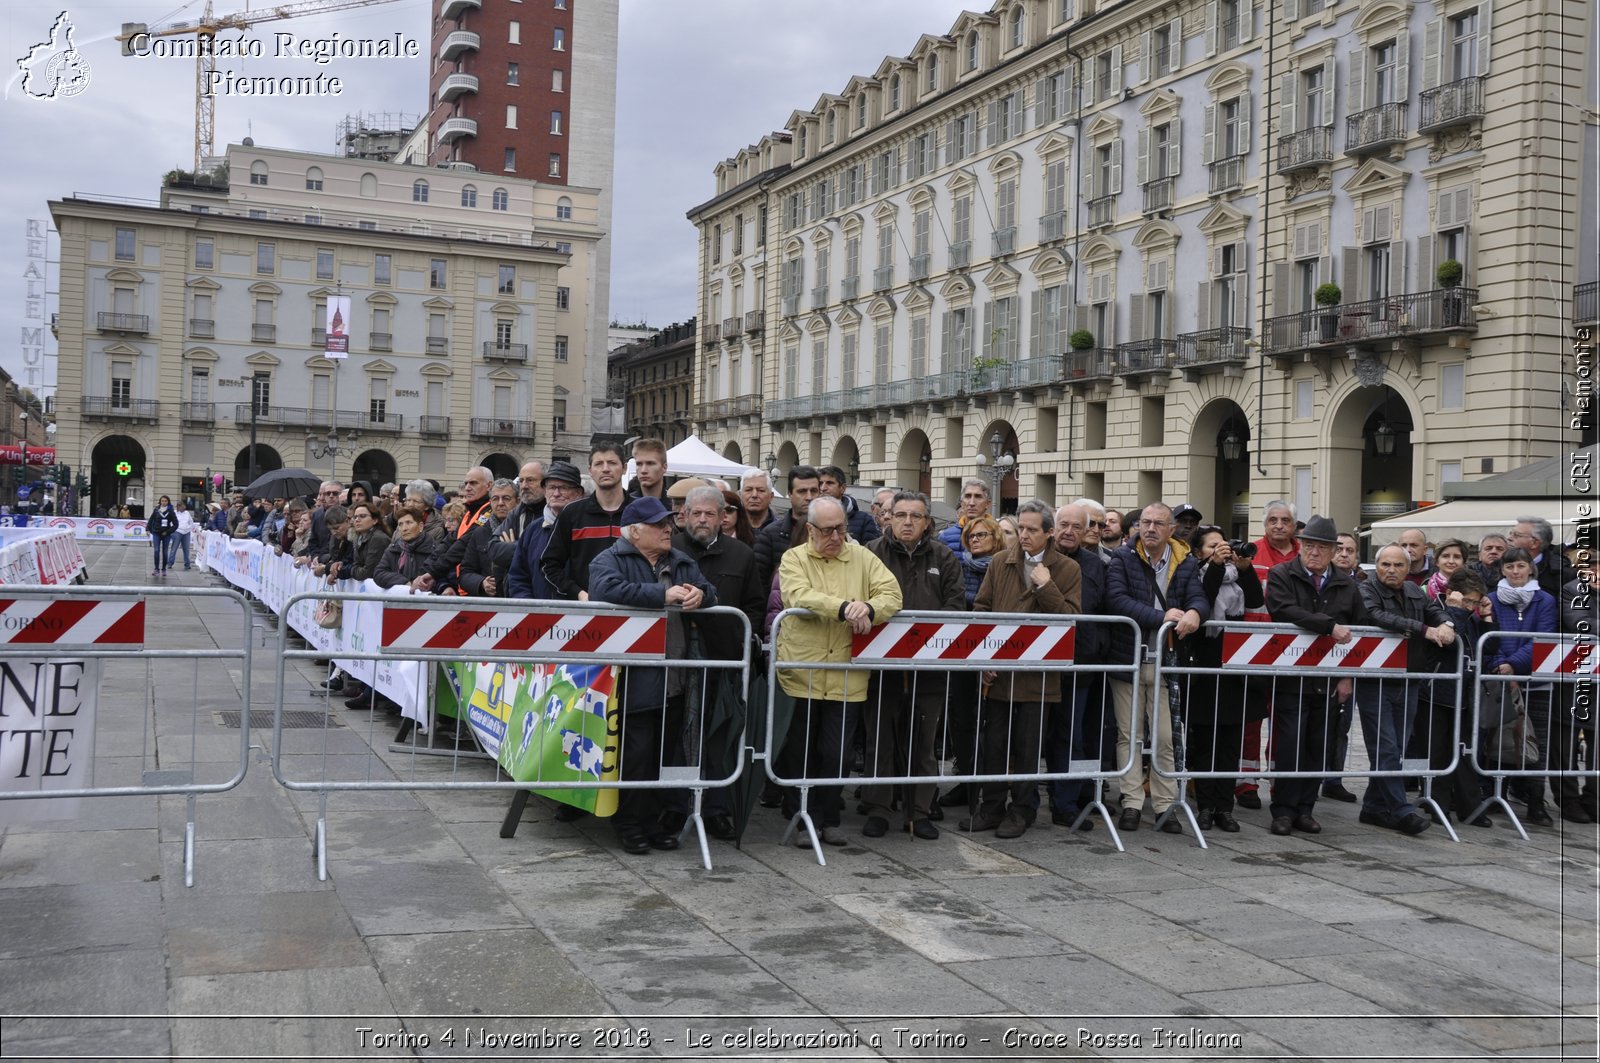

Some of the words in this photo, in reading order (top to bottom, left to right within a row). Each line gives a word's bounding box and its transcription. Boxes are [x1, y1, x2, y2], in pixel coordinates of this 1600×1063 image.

[23, 218, 43, 320] REALE
[547, 624, 602, 642] TORINO
[982, 636, 1025, 650] TORINO
